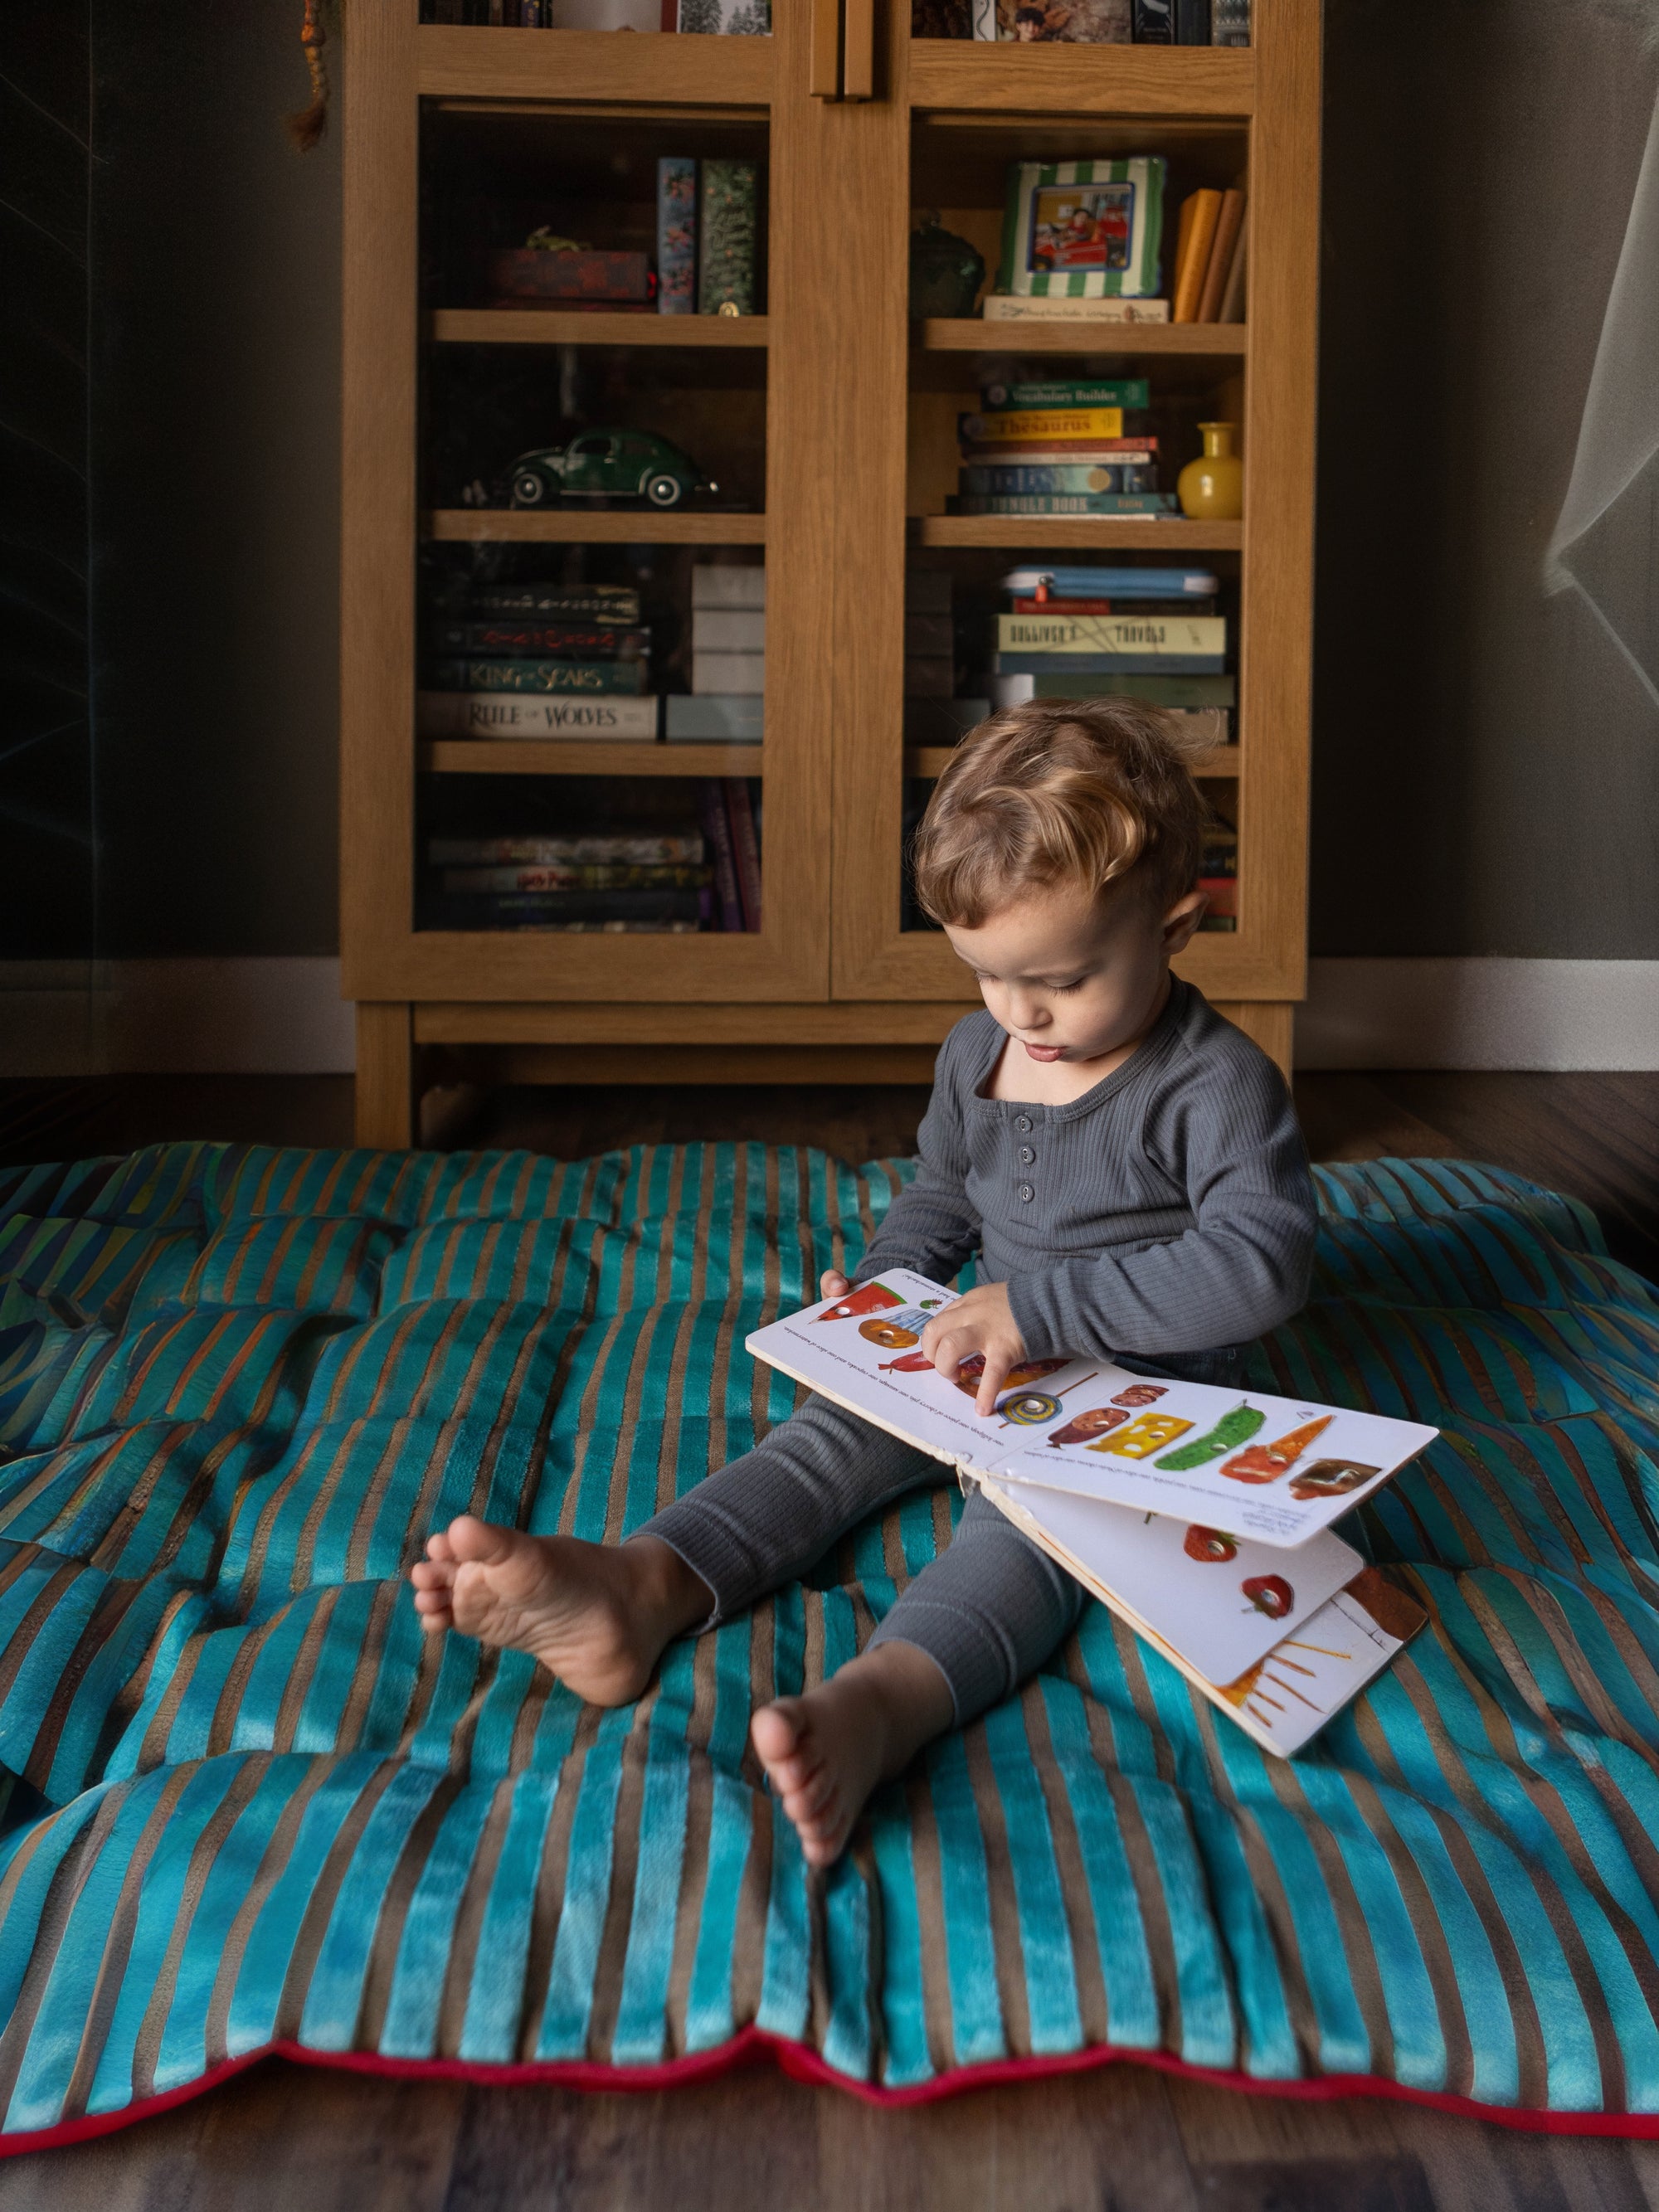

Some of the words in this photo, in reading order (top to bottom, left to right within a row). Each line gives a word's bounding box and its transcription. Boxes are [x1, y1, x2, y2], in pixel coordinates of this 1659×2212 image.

[996, 419, 1092, 434] Thesaurus
[469, 702, 520, 727] RULE
[545, 701, 616, 728] WOLVES
